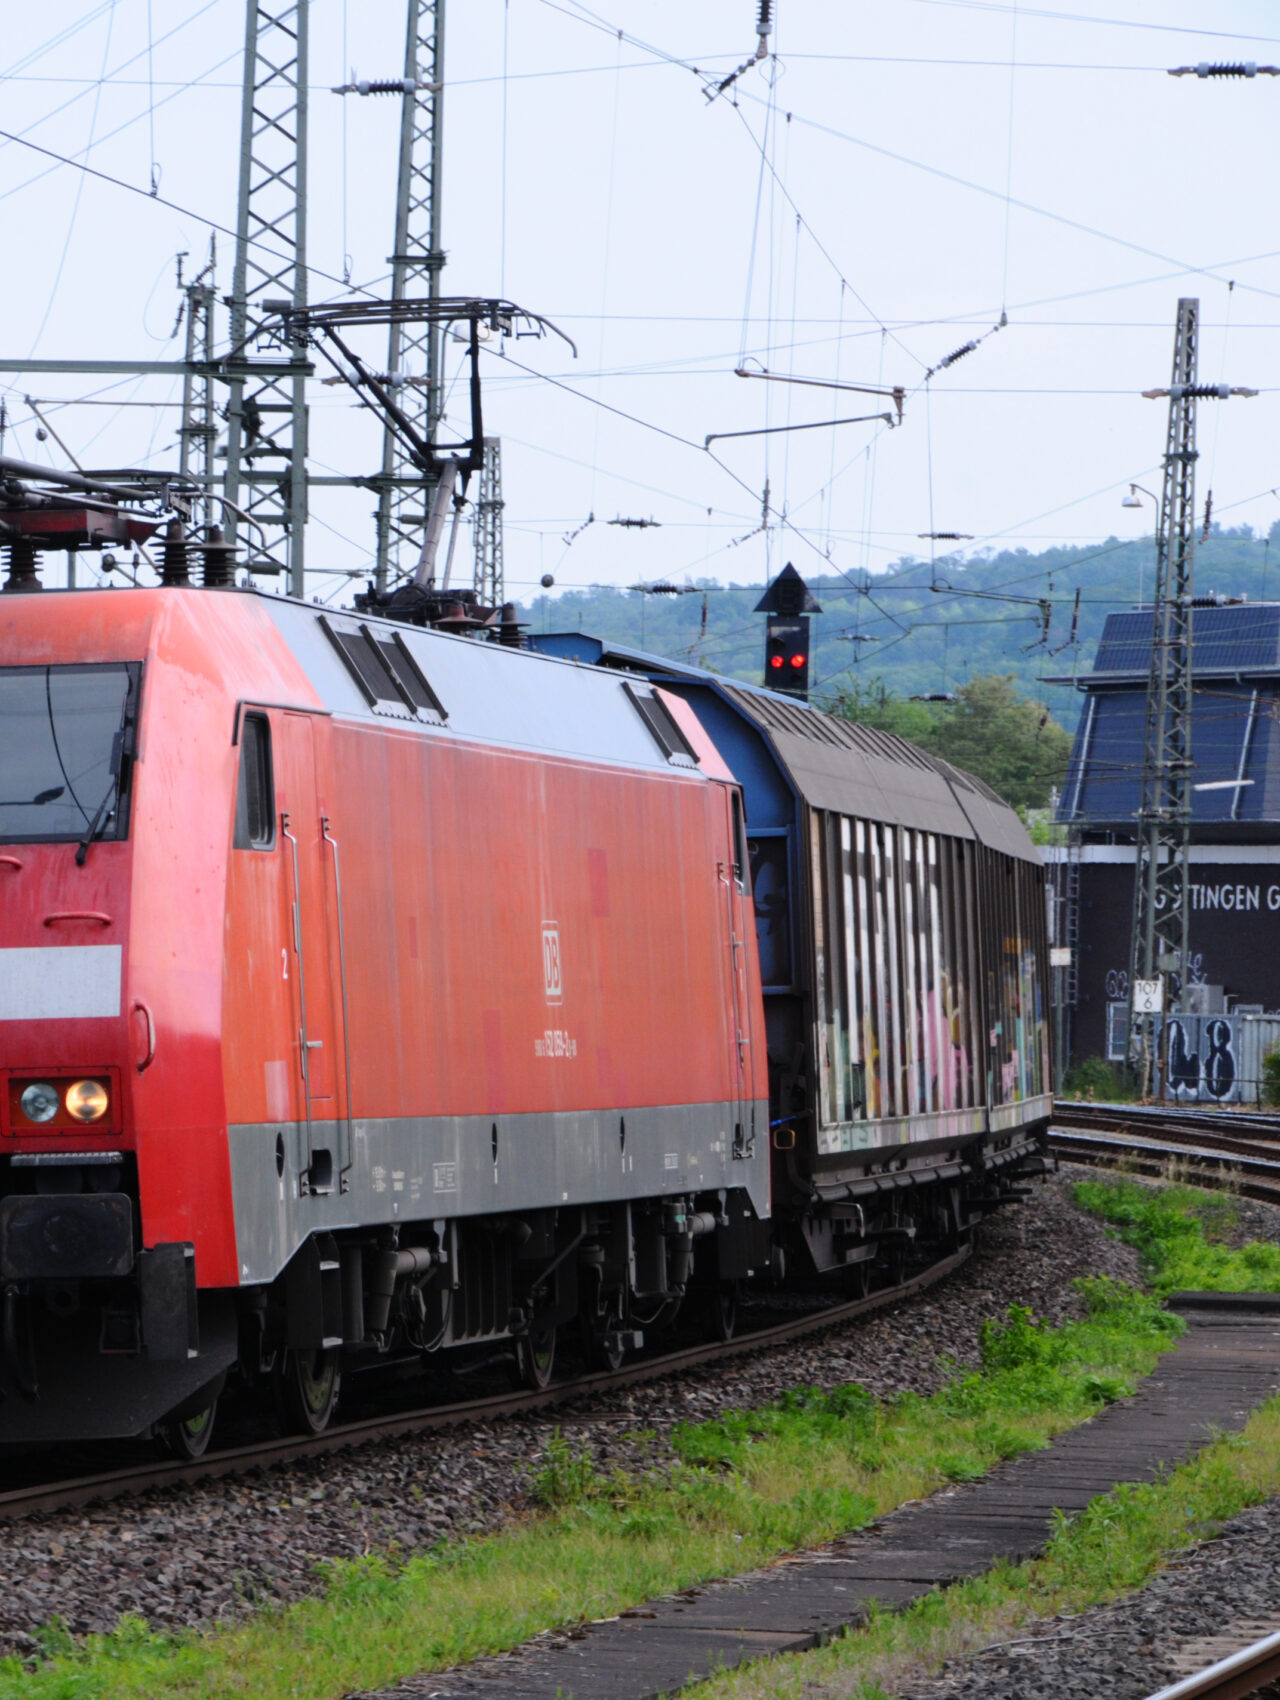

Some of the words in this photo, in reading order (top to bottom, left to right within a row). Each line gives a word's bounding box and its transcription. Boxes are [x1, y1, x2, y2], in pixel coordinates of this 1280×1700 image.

[282, 948, 289, 980] 2
[542, 934, 561, 989] DB
[1136, 982, 1159, 996] 107
[1143, 997, 1153, 1010] 6
